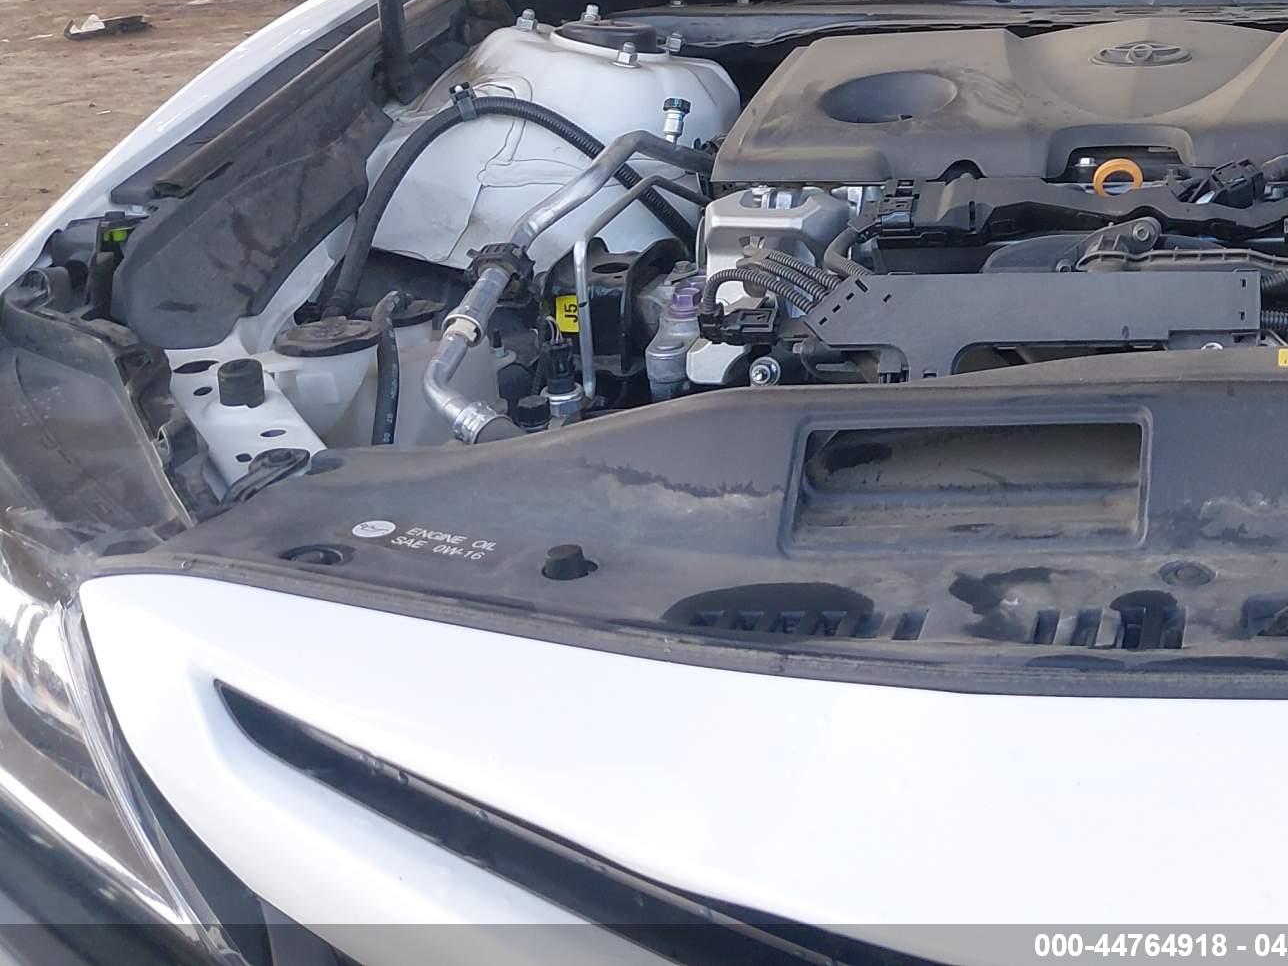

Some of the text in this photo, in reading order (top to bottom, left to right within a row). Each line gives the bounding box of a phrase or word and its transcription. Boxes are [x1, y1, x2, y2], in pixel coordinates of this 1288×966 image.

[564, 303, 578, 323] J5
[391, 536, 485, 560] SAE 0W-16
[406, 527, 496, 552] ENGINE OIL
